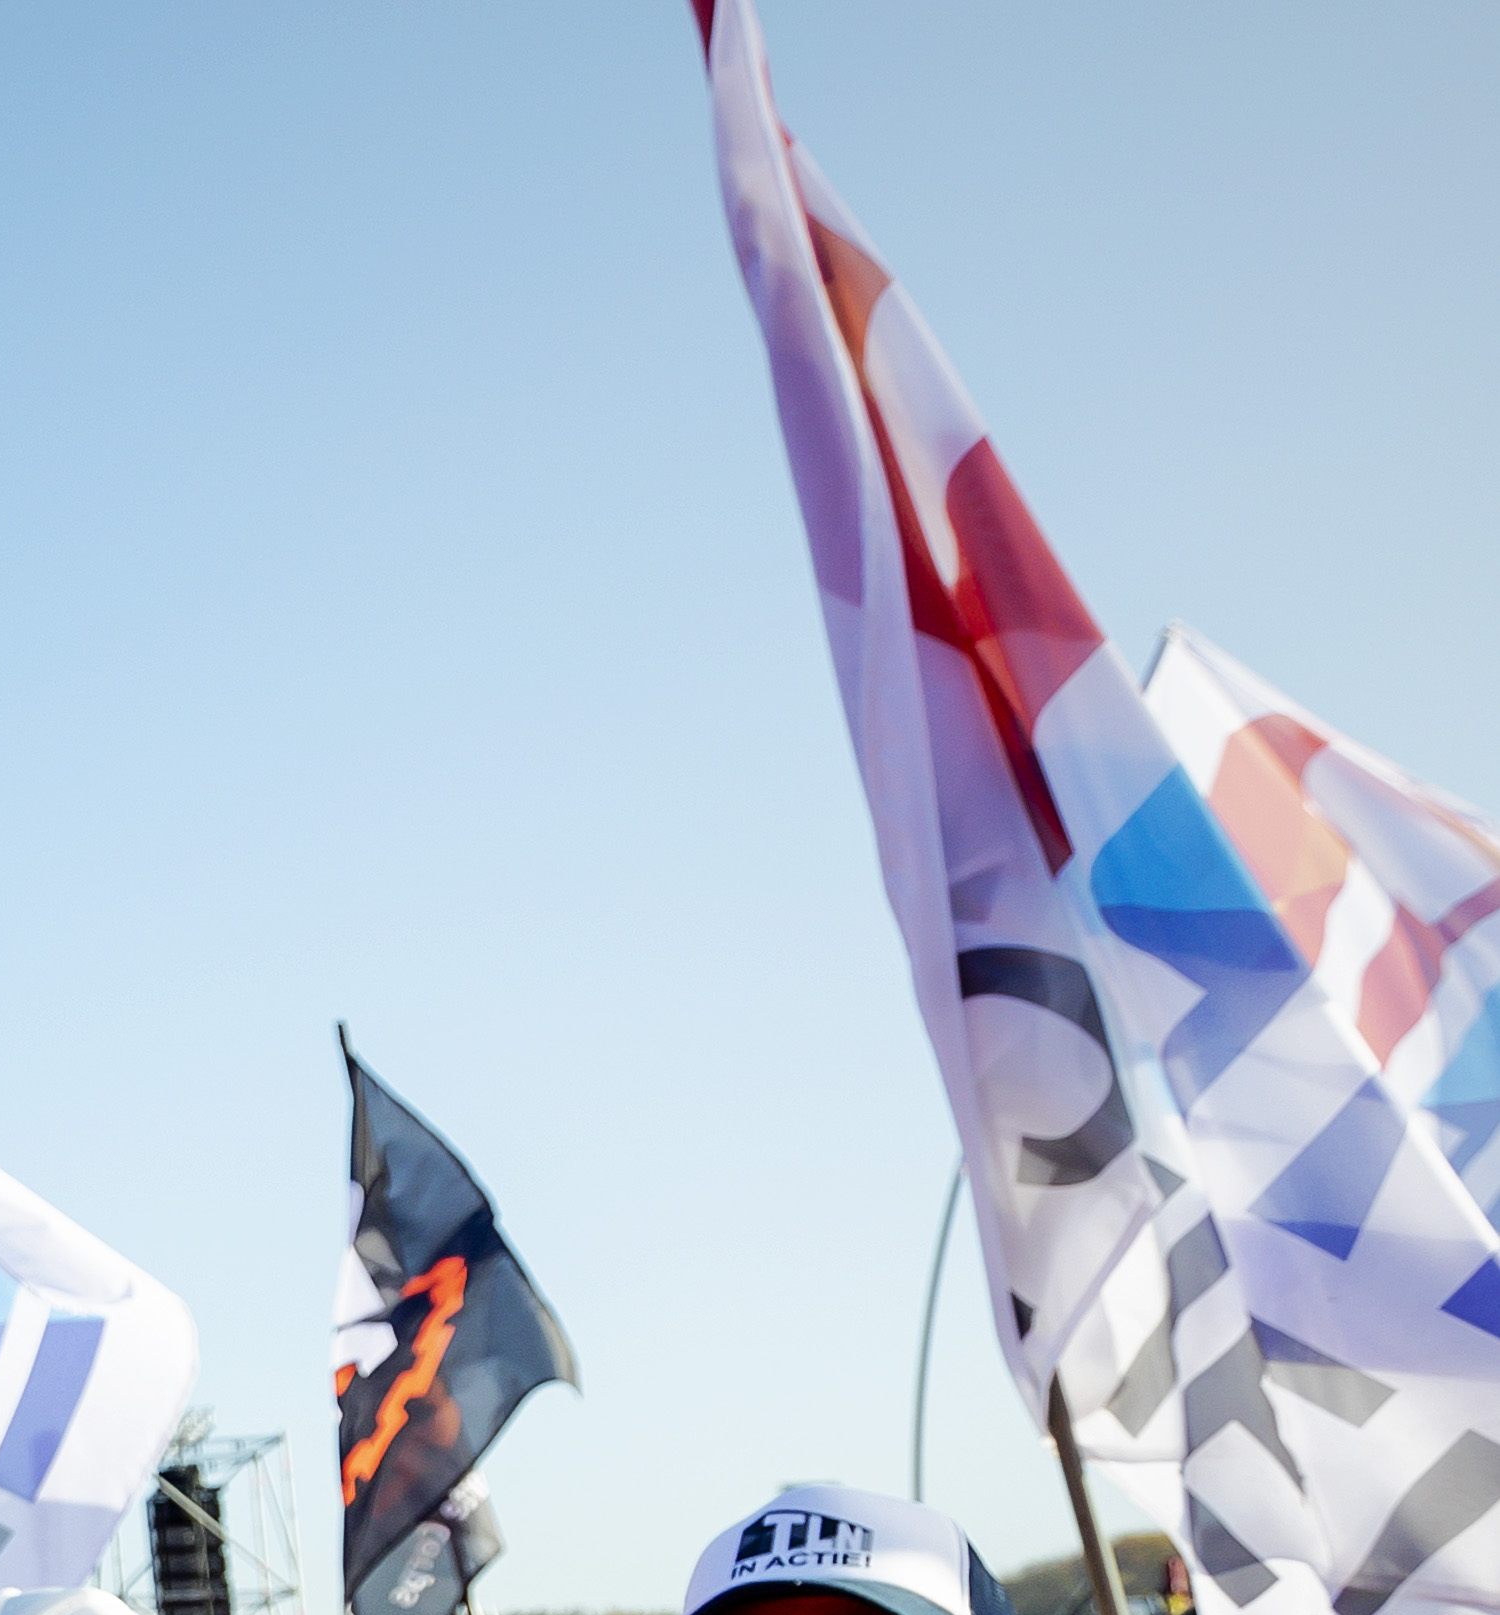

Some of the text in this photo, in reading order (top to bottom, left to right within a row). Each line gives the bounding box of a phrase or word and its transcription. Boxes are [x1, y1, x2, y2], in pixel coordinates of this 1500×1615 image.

[760, 1510, 868, 1554] TLN
[731, 1551, 871, 1580] IN ACTIE!
